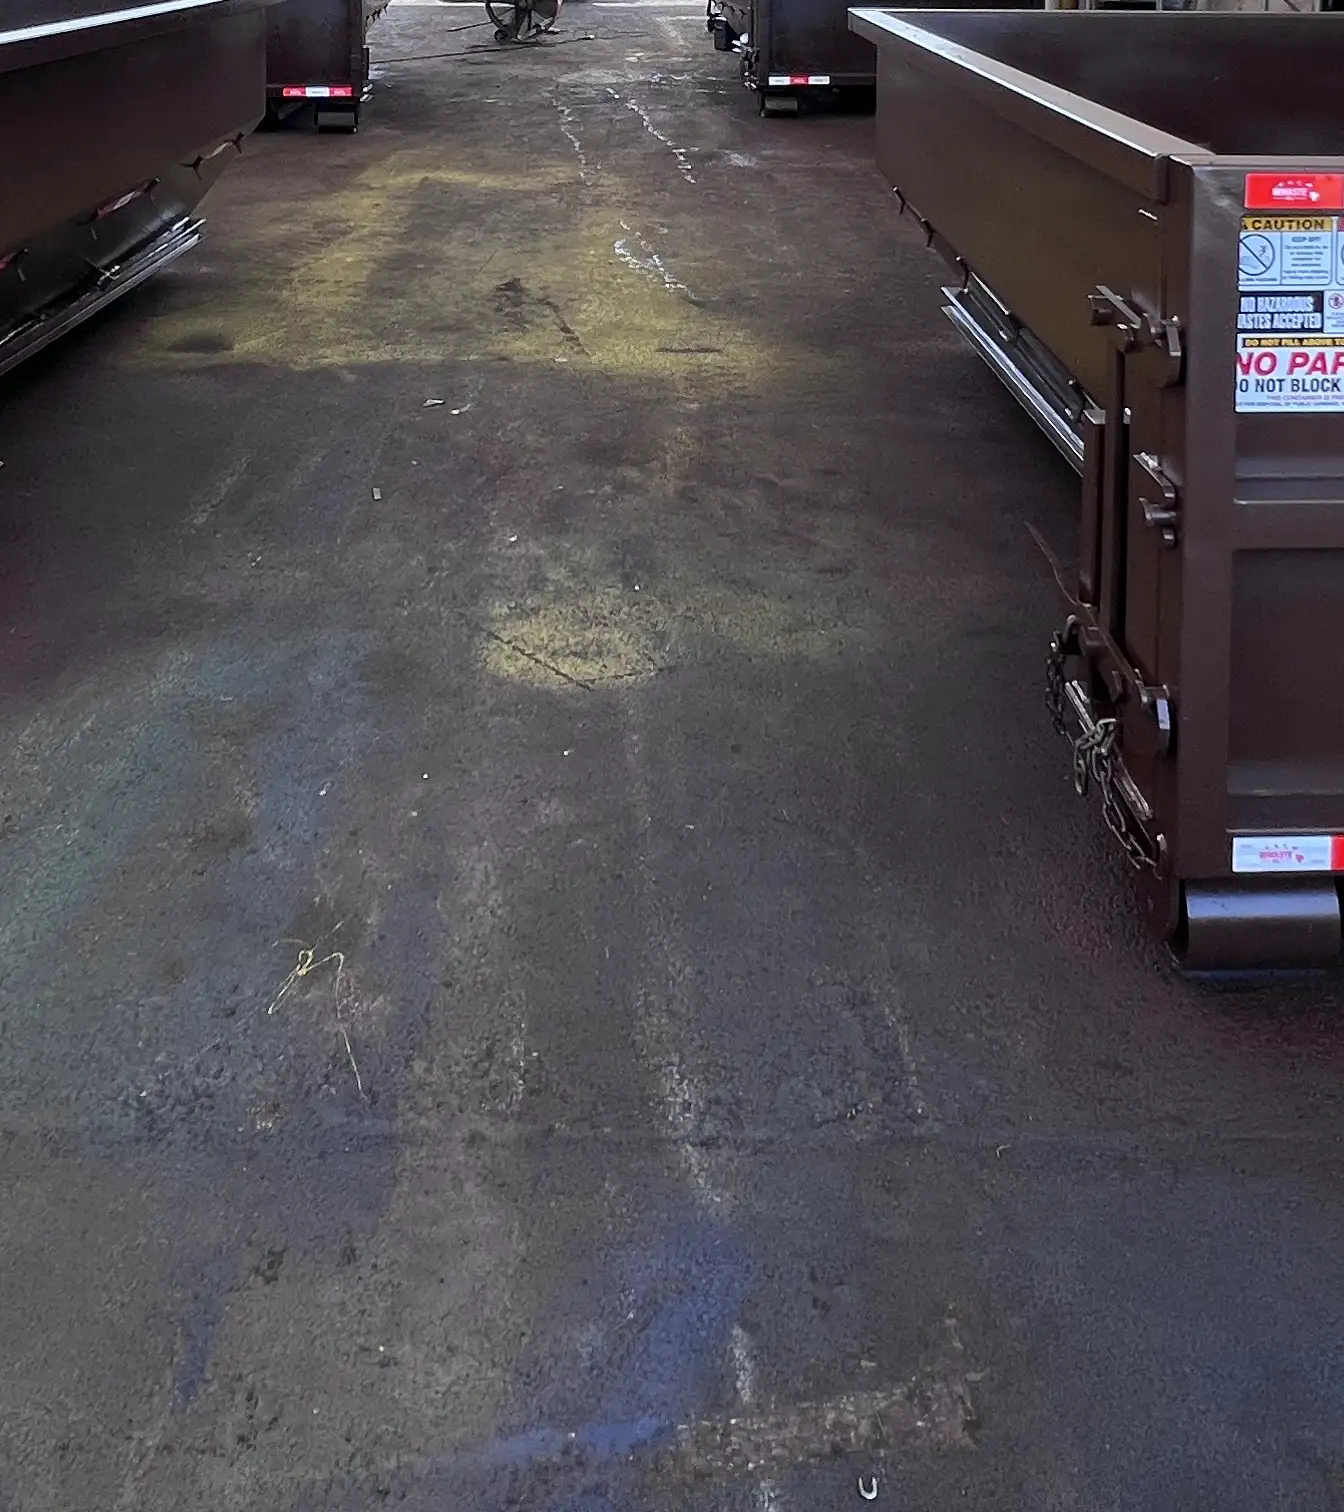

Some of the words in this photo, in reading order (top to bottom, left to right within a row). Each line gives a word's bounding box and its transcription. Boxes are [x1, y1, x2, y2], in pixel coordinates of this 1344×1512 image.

[1252, 219, 1324, 230] CAUTION
[1237, 313, 1271, 329] ASTES
[1272, 312, 1322, 328] ACCEPTED
[1236, 351, 1277, 376] NO
[1235, 378, 1249, 393] O
[1255, 378, 1286, 393] NOT
[1291, 378, 1341, 392] BLOCK
